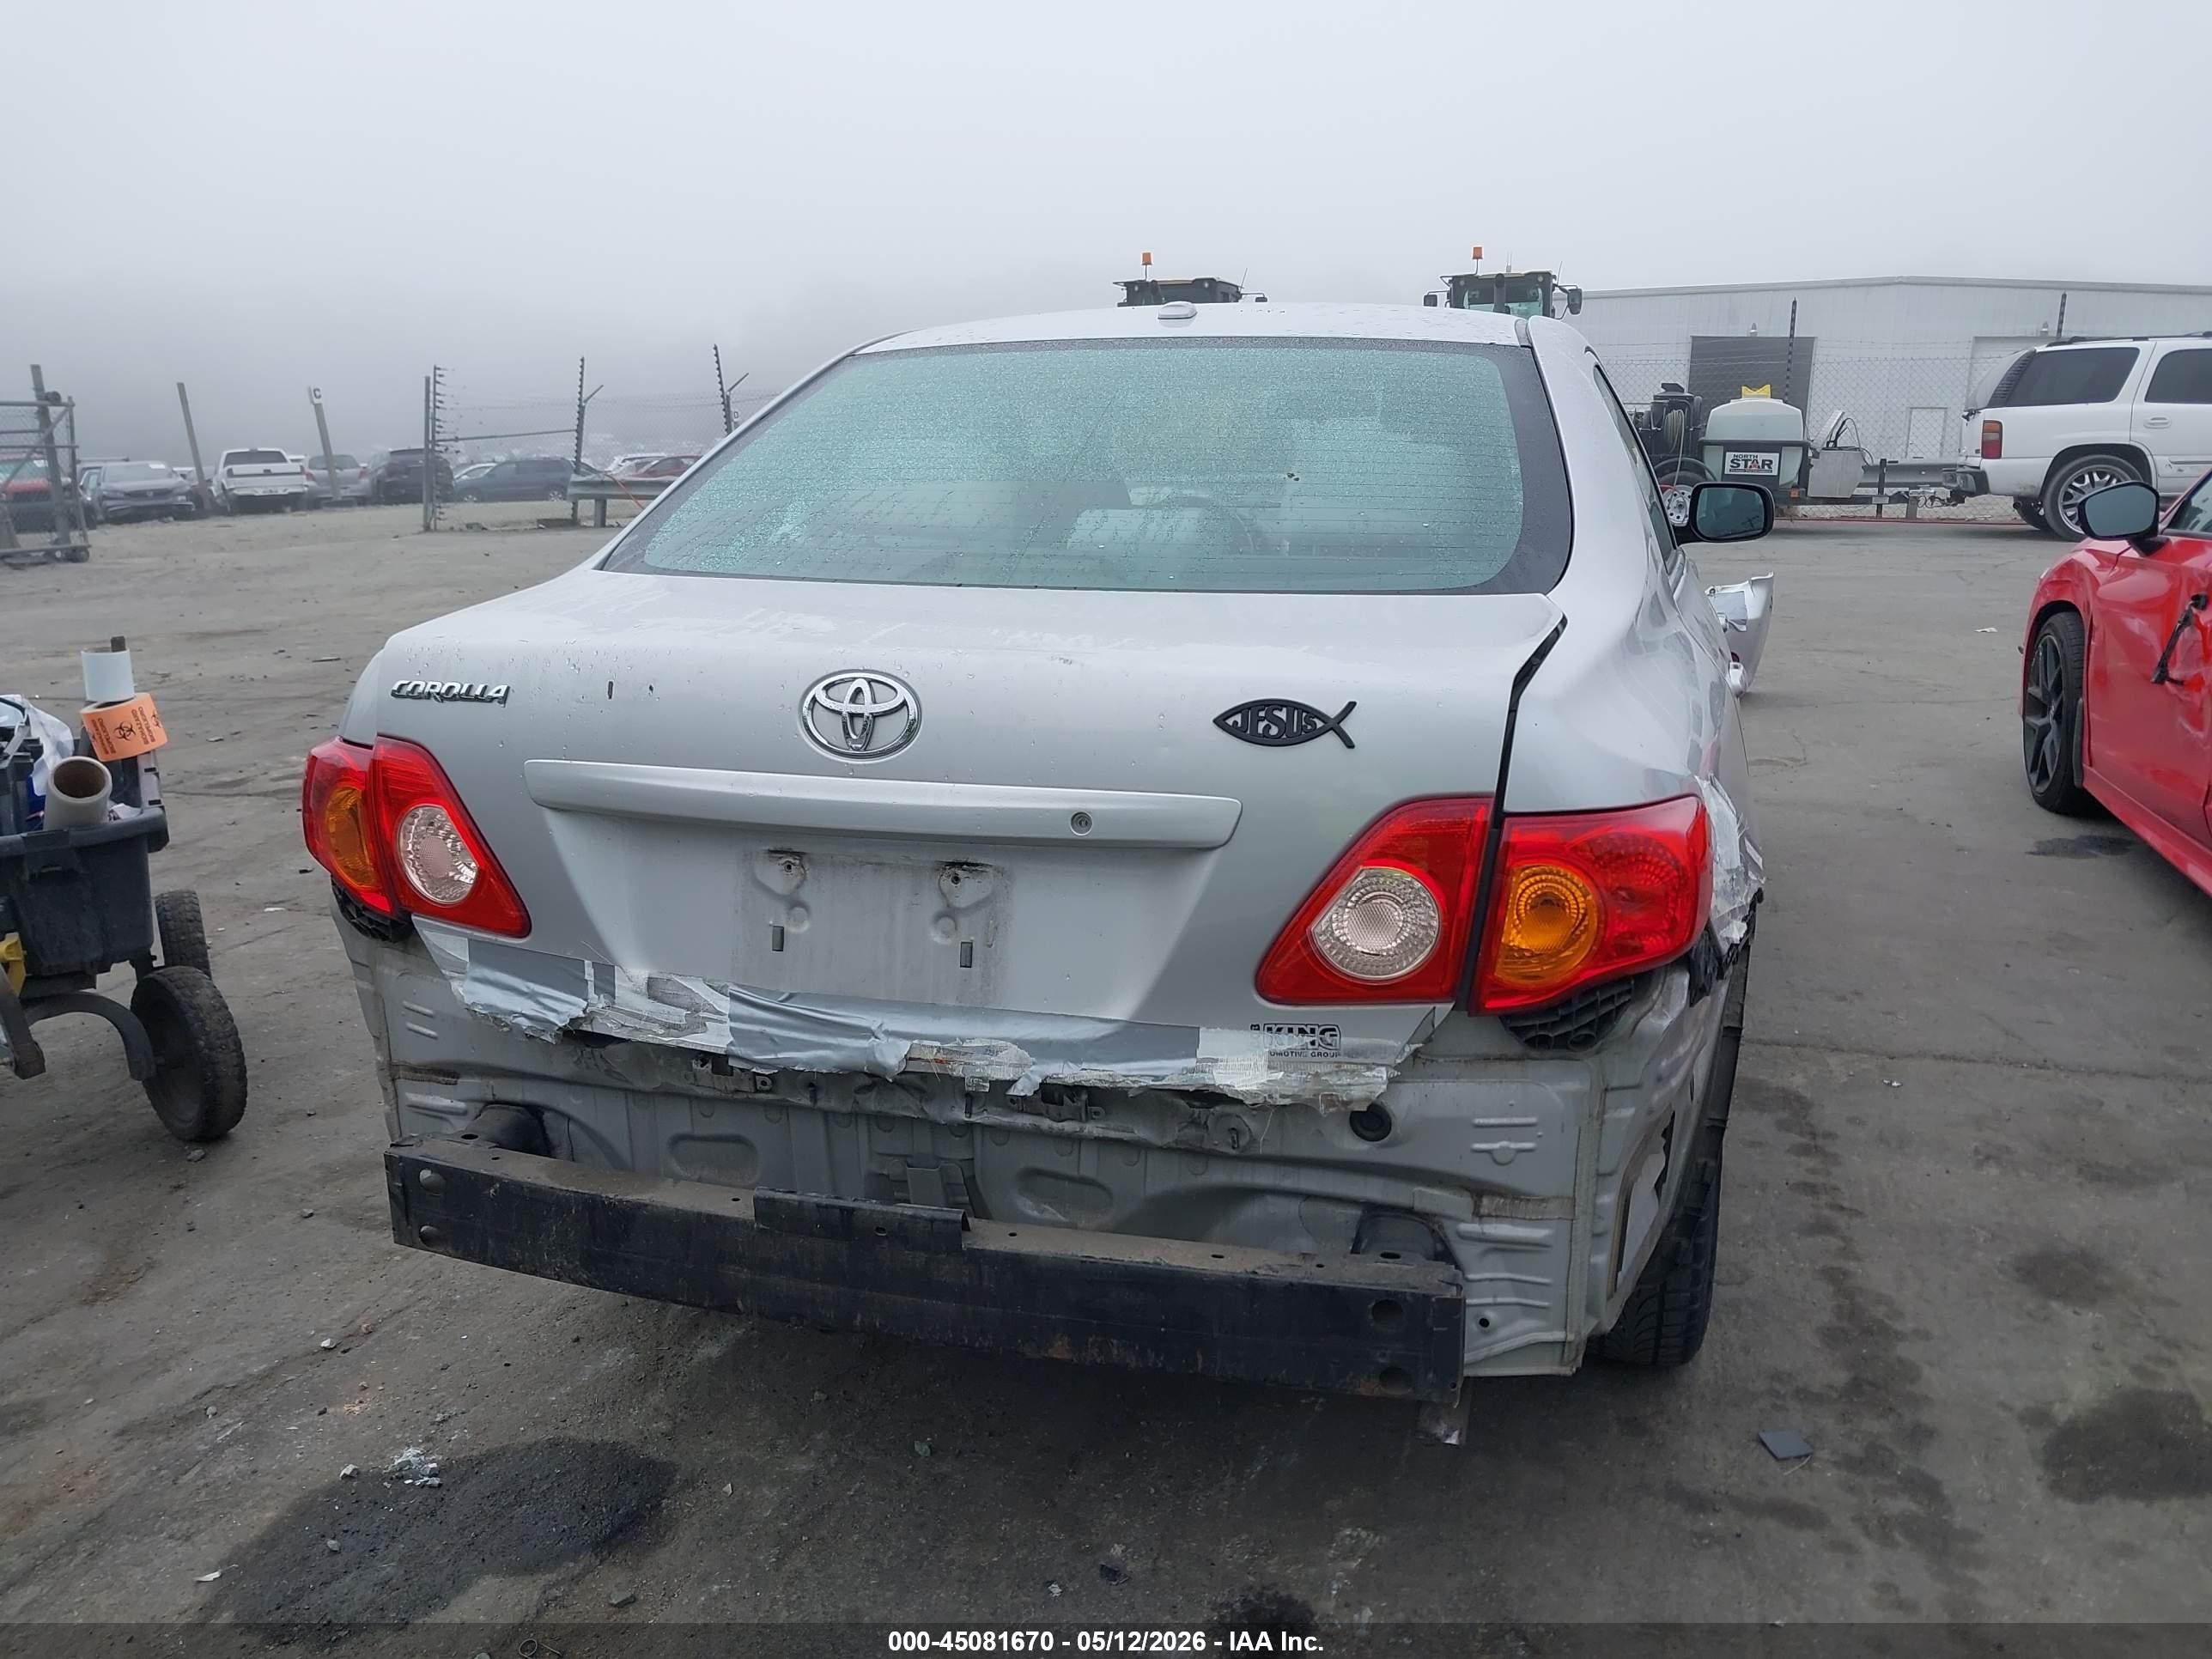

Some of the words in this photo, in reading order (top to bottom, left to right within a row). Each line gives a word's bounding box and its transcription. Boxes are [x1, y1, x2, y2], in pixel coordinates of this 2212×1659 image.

[313, 387, 322, 399] C
[1729, 458, 1773, 469] STAR
[391, 679, 510, 708] COROLLA
[131, 708, 149, 744] BIOHAZARD
[138, 706, 156, 743] BIOPELIGRO
[1231, 704, 1317, 739] JESUS
